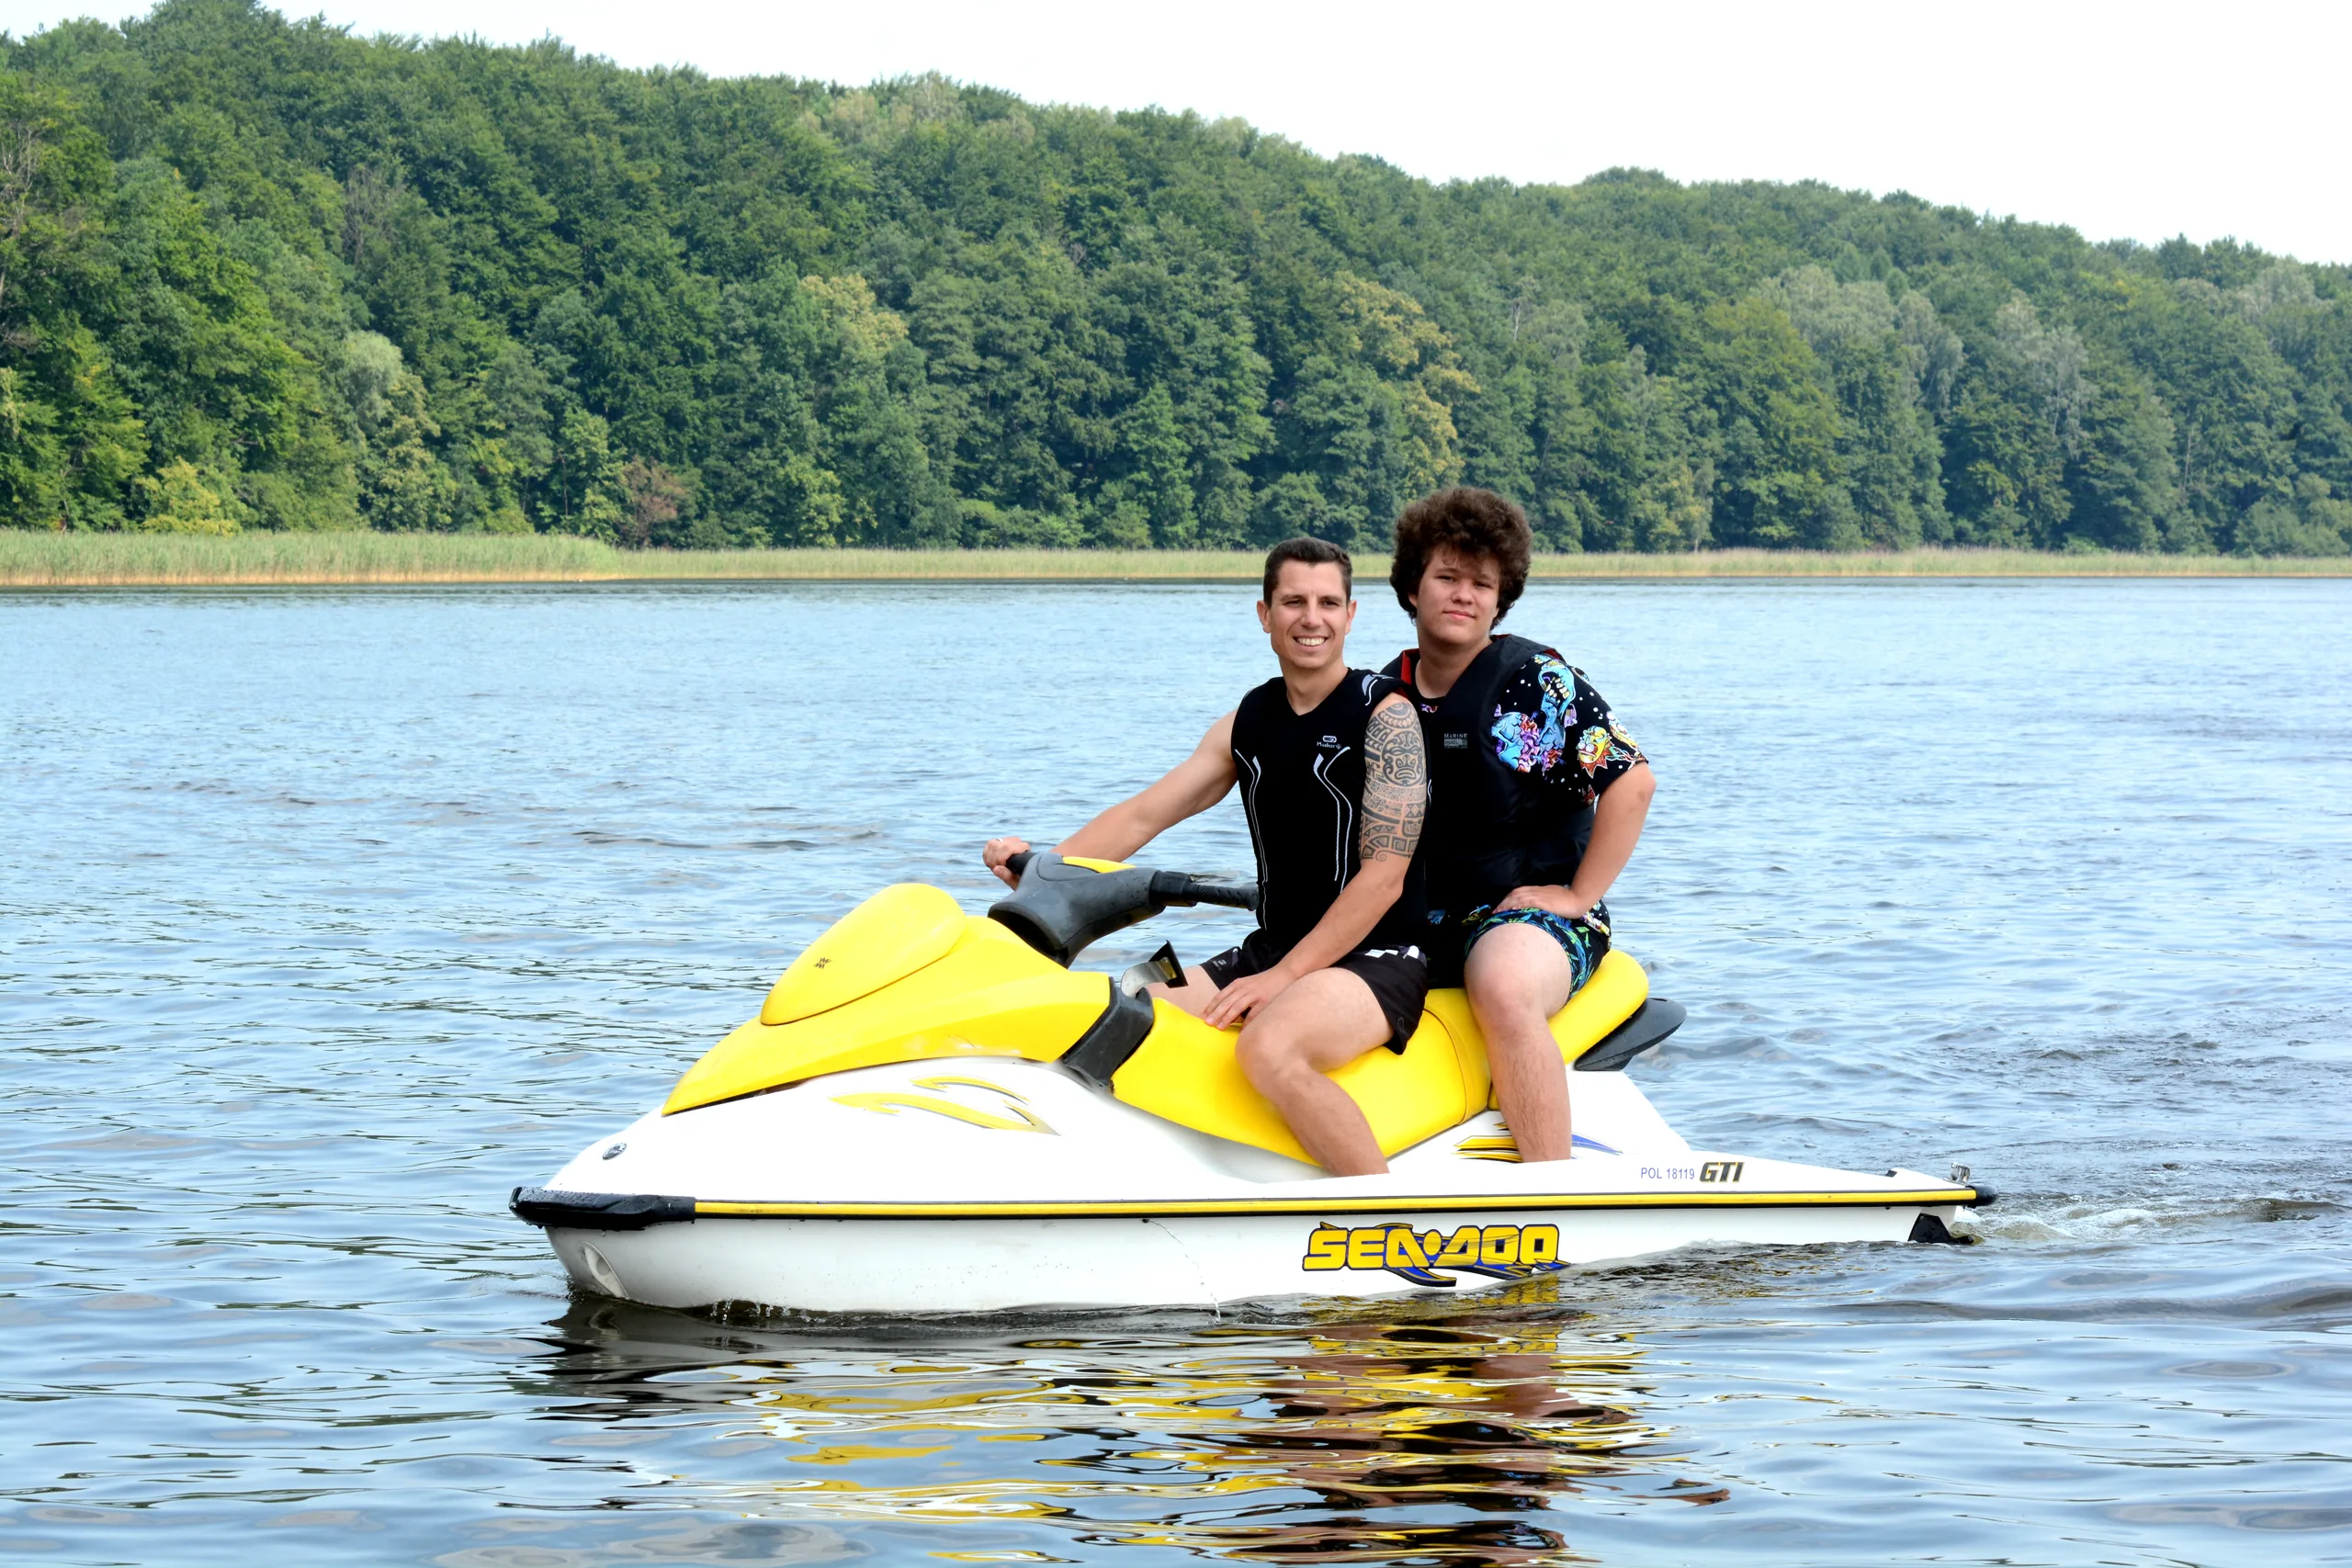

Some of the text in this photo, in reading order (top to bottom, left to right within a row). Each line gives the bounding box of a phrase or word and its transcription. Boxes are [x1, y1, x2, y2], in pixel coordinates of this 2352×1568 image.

[1641, 1168, 1695, 1179] POL 18119
[1700, 1161, 1745, 1183] GTI
